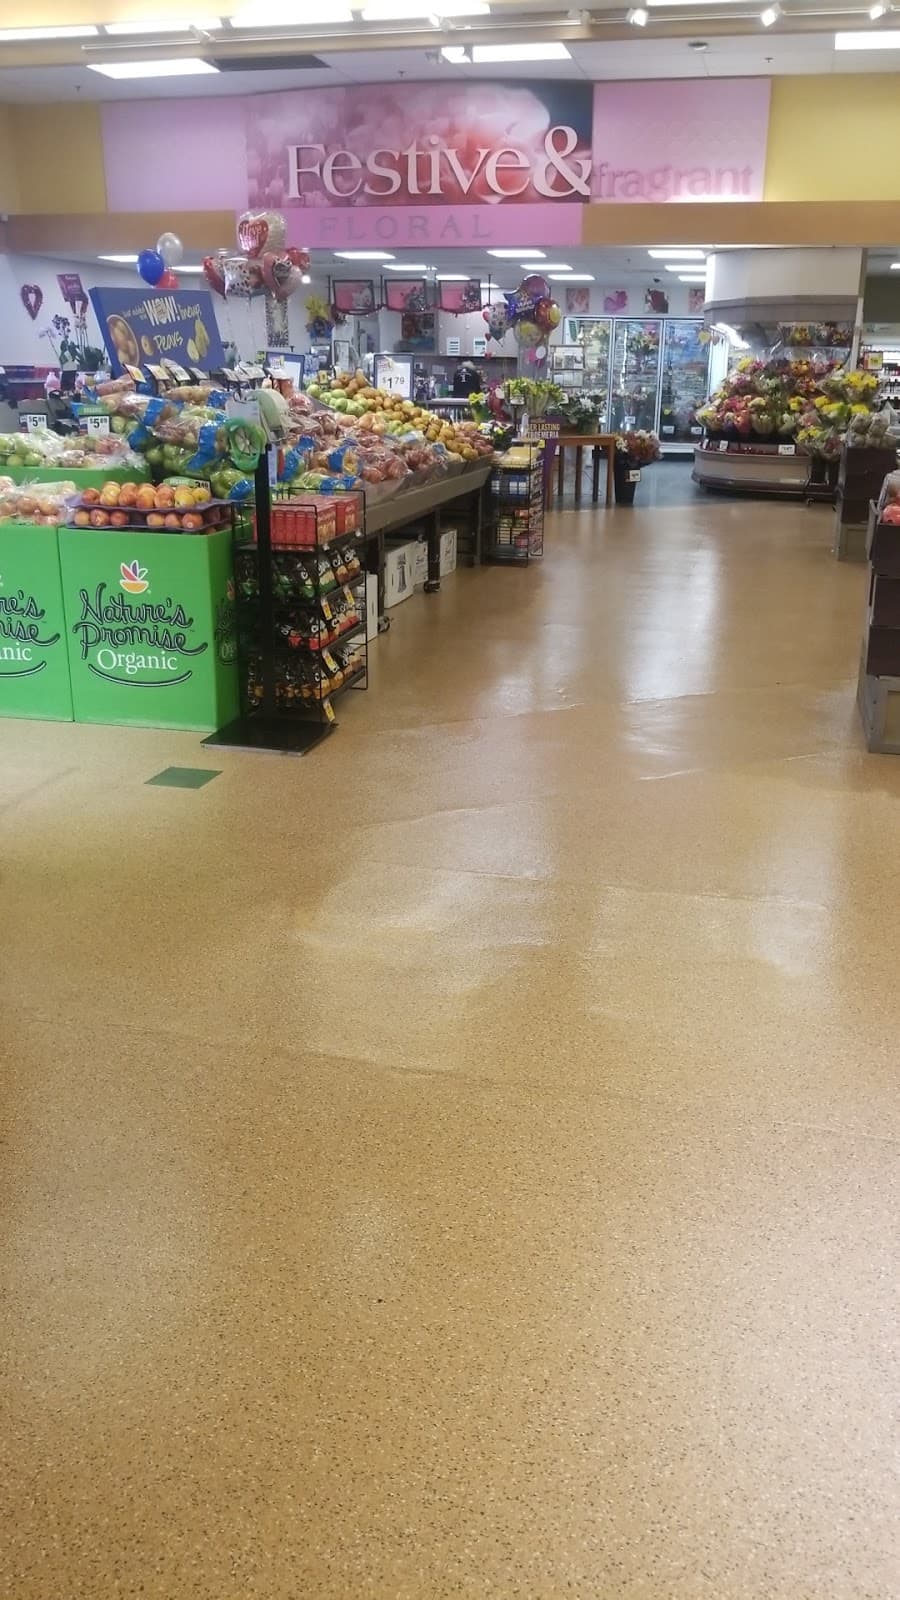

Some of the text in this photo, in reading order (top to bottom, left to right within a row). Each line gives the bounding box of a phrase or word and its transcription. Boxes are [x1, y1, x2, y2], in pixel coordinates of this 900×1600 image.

[287, 125, 753, 203] Festive & fragrant
[319, 213, 496, 241] FLORAL
[538, 423, 560, 432] LASTING
[79, 582, 194, 628] Nature's
[72, 622, 208, 660] Promise
[97, 649, 178, 675] Organic
